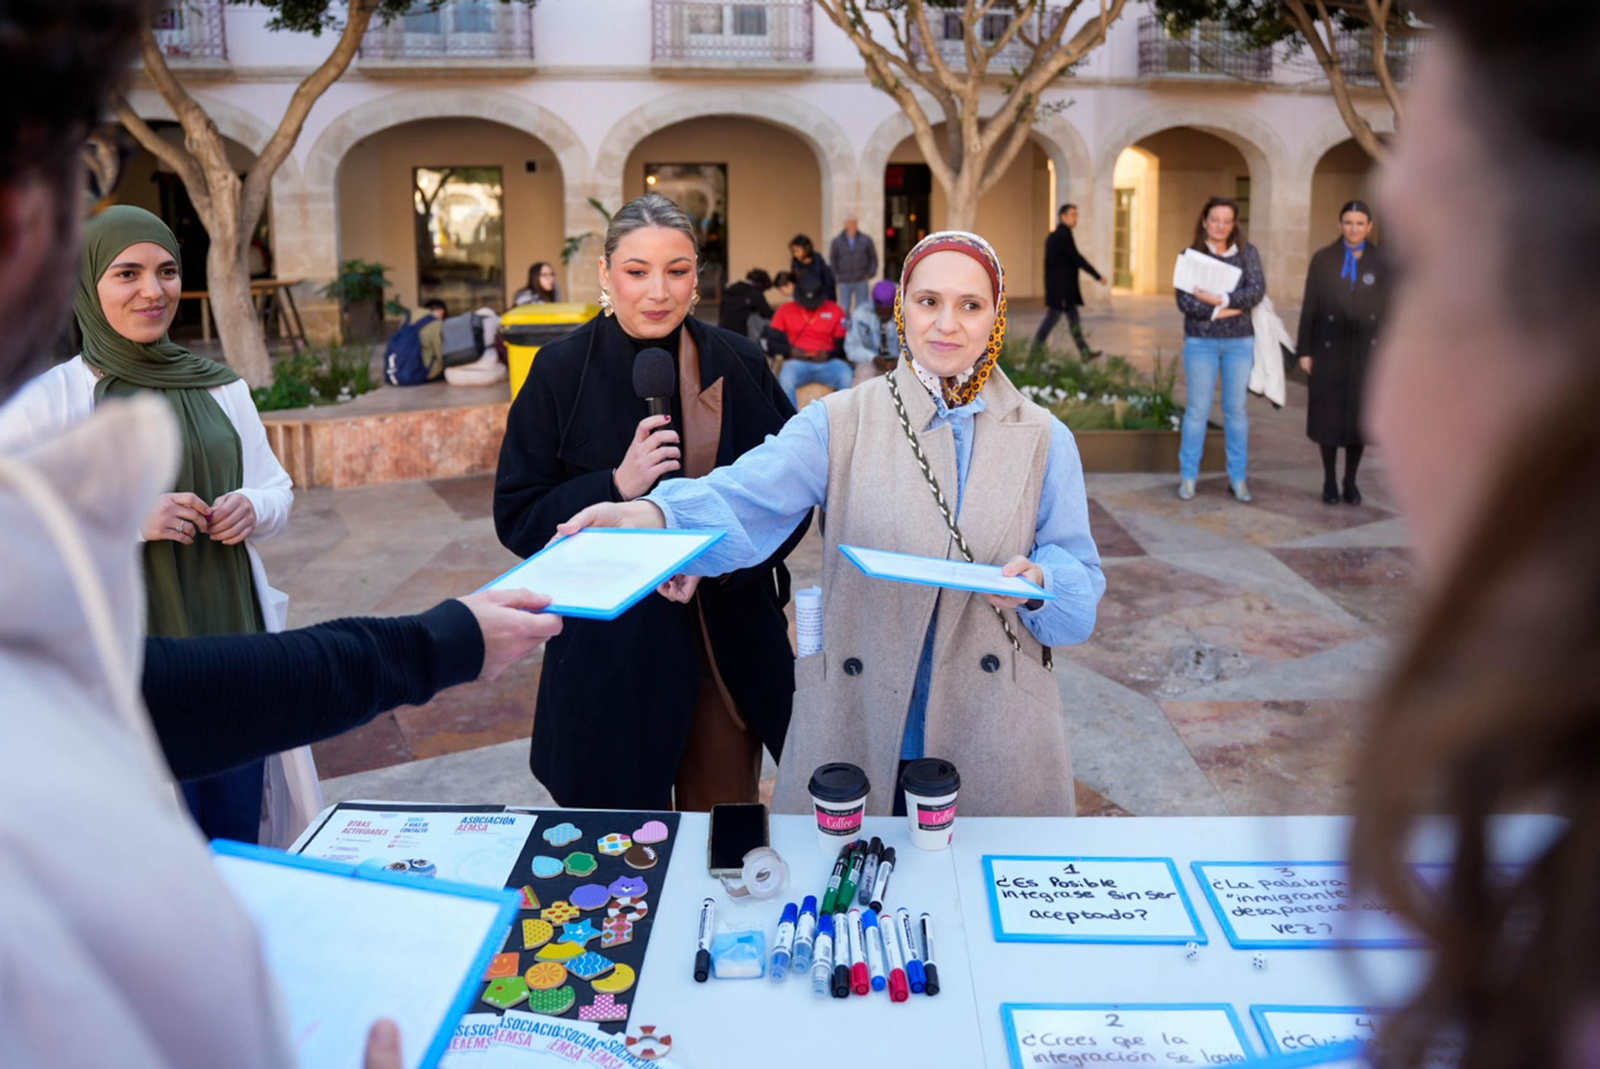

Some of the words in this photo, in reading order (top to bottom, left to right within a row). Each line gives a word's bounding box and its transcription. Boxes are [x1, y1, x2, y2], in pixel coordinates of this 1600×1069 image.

[346, 820, 372, 828] OTRAS
[826, 816, 853, 829] Coffee
[341, 828, 390, 836] ACTIVIDADES
[1063, 863, 1080, 874] 1
[1274, 867, 1295, 877] 3
[1002, 889, 1095, 903] integrase
[1029, 908, 1148, 925] aceptado?
[1105, 1013, 1124, 1027] 2
[1162, 1032, 1188, 1045] la
